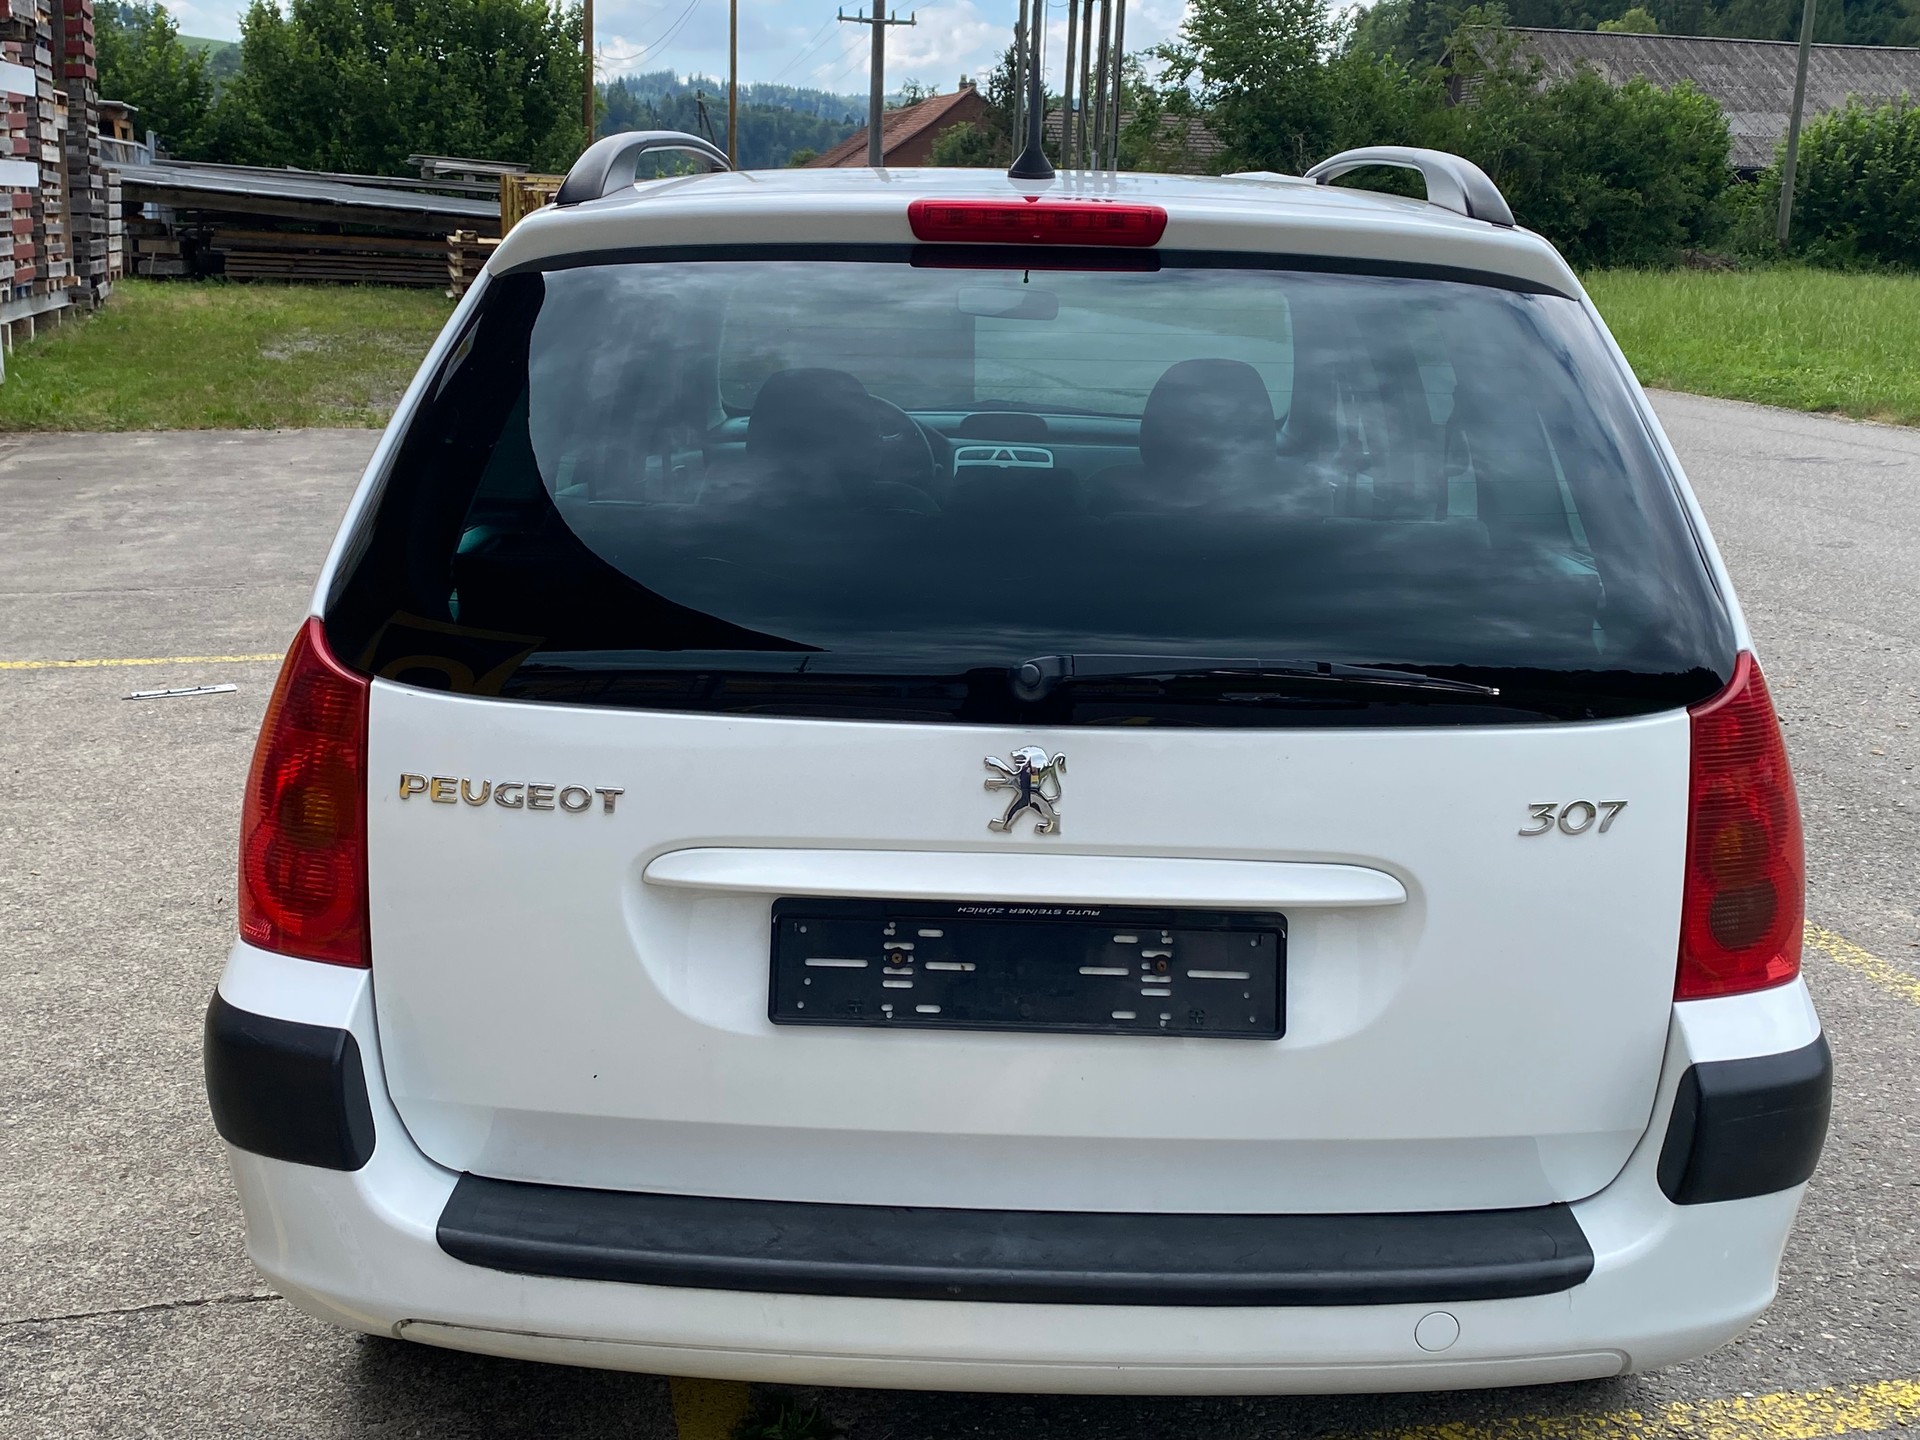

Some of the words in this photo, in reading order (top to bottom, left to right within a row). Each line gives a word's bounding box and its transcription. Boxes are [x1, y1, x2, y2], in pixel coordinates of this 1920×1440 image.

[399, 772, 625, 814] PEUGEOT
[1518, 798, 1629, 836] 307
[1066, 909, 1101, 917] AUTO
